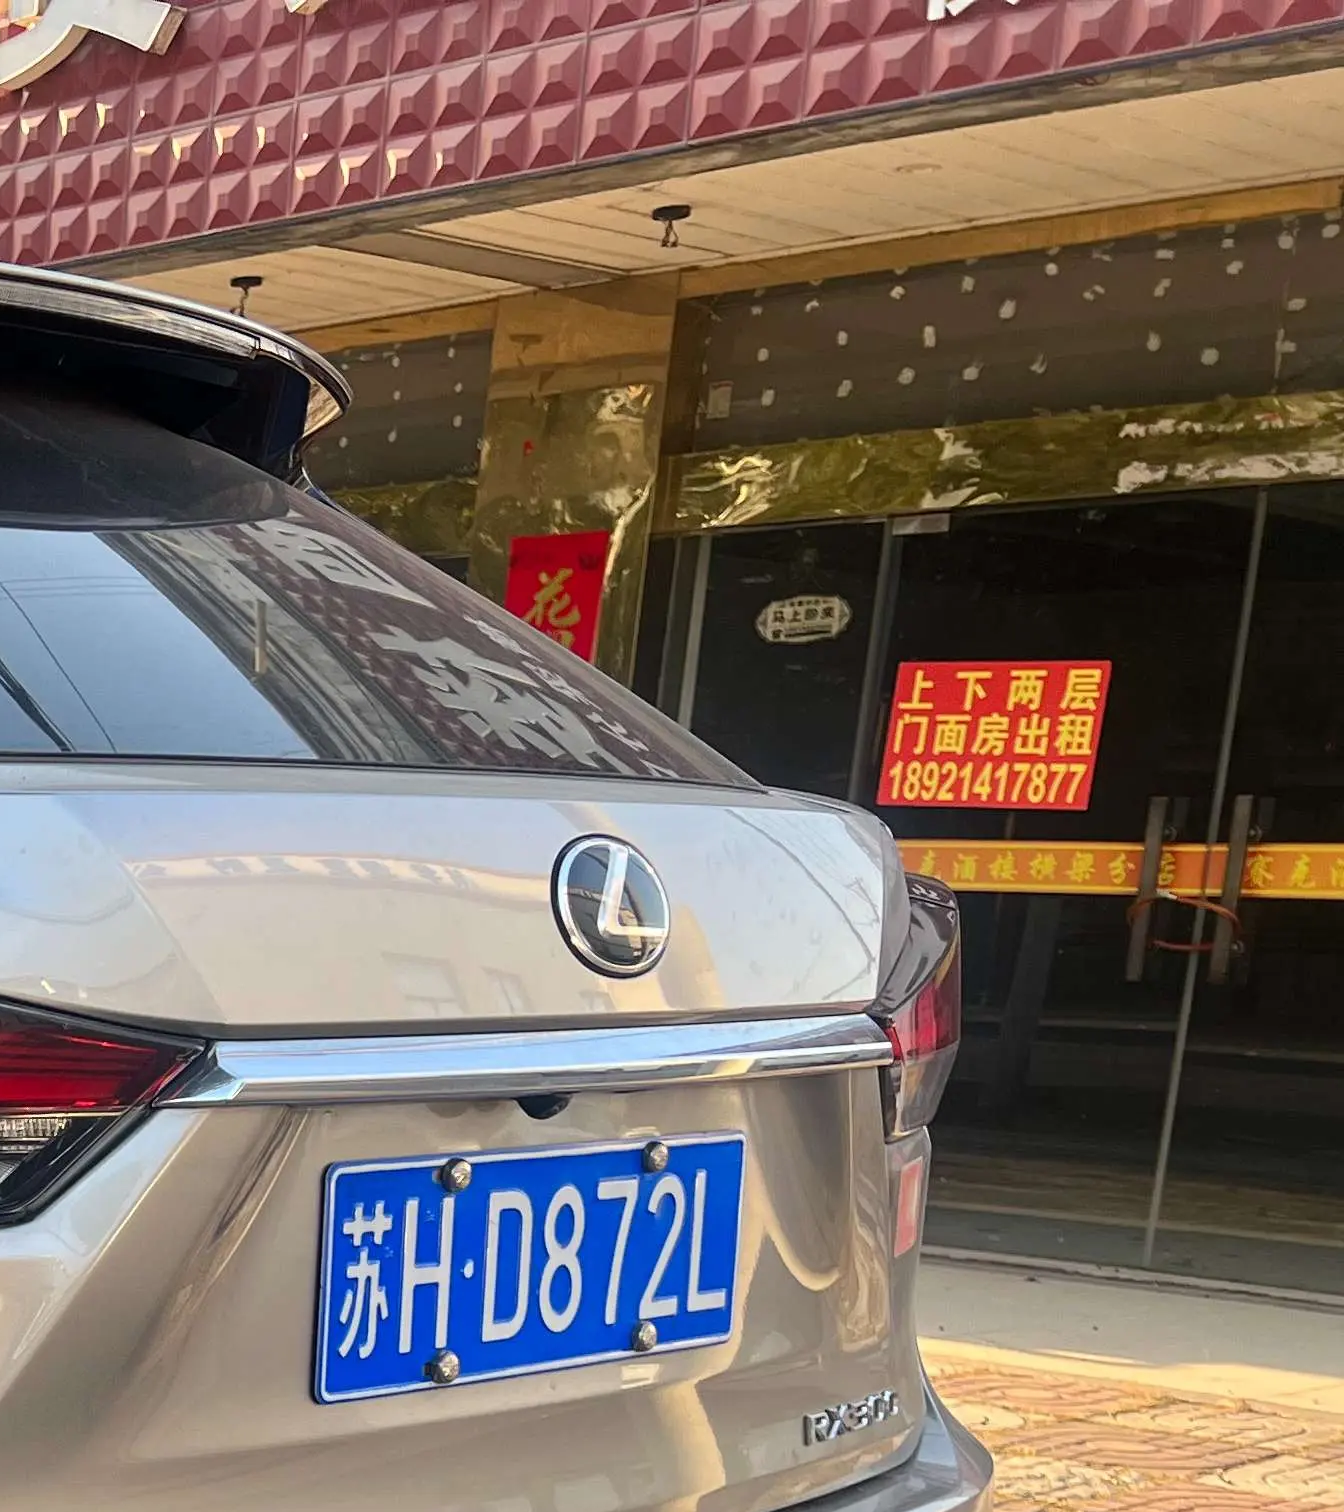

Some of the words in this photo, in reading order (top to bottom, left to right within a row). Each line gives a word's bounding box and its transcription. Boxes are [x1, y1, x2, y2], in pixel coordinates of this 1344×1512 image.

[898, 669, 1102, 711] 上下两层
[893, 712, 1095, 756] 门面房出租
[889, 760, 1088, 804] 18921417877
